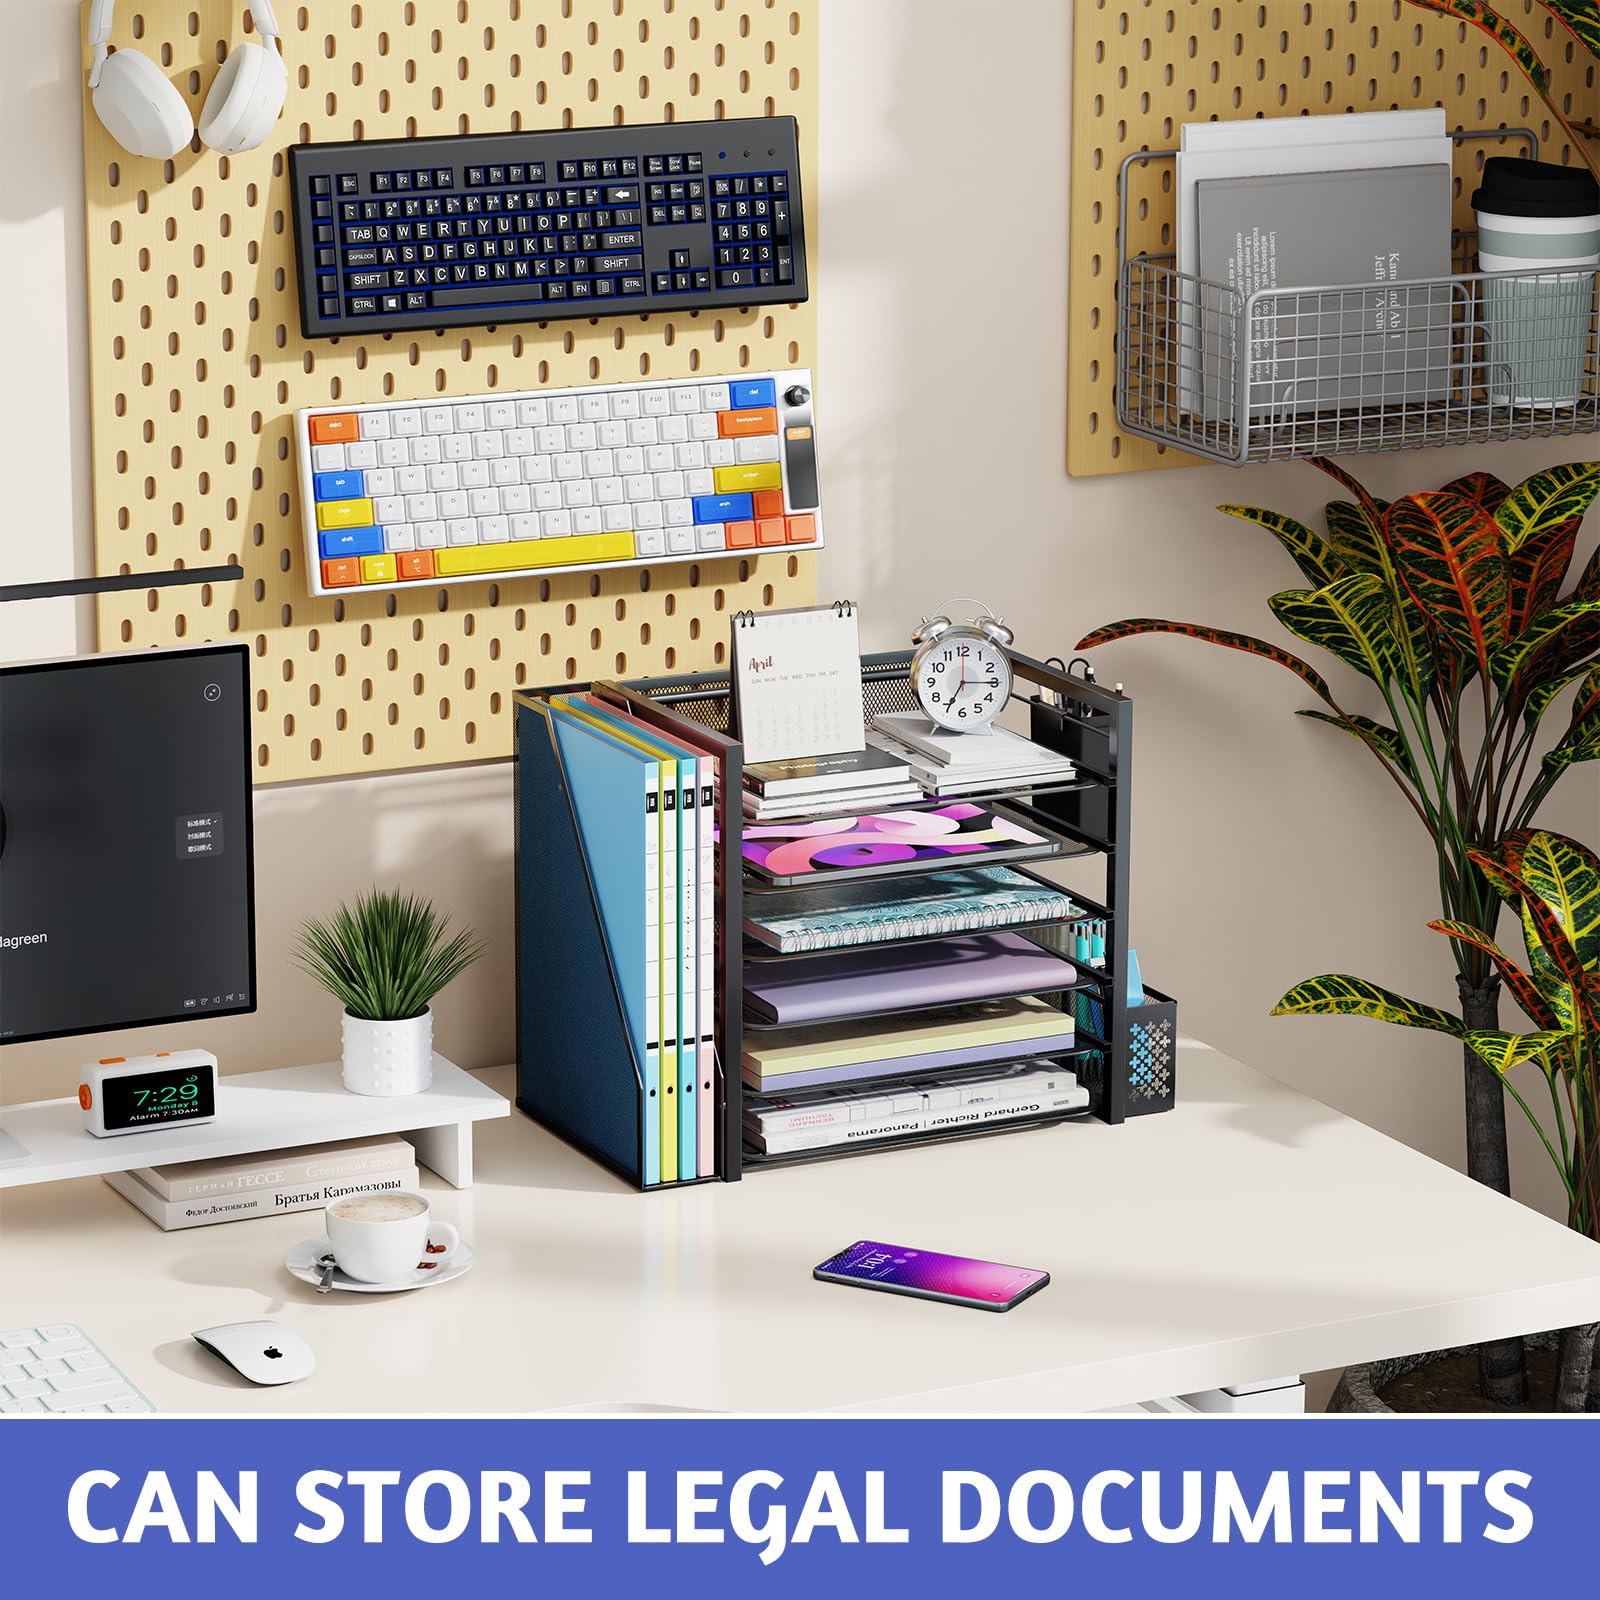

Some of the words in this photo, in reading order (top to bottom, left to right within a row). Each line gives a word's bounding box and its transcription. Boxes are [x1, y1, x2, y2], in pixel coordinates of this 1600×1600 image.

[584, 165, 596, 173] F10
[721, 205, 726, 215] 7
[739, 204, 746, 214] 8
[758, 203, 765, 213] 9
[351, 229, 370, 240] TAB
[379, 228, 388, 238] Q
[398, 227, 409, 236] W
[420, 225, 427, 235] E
[440, 224, 449, 234] R
[461, 223, 467, 232] T
[480, 221, 488, 231] Y
[500, 220, 509, 230] U
[522, 219, 526, 229] I
[539, 218, 549, 228] O
[560, 216, 568, 226] P
[722, 228, 729, 238] 4
[741, 226, 748, 237] 5
[760, 225, 767, 236] 6
[385, 250, 395, 261] A
[405, 249, 413, 260] S
[426, 247, 434, 257] D
[447, 246, 454, 256] F
[466, 245, 475, 255] G
[487, 243, 494, 254] H
[508, 242, 514, 252] J
[527, 240, 535, 250] K
[547, 239, 553, 248] L
[609, 235, 634, 244] ENTER
[724, 250, 729, 261] 1
[743, 249, 750, 259] 2
[762, 248, 769, 258] 3
[354, 275, 381, 285] SHIFT
[397, 272, 405, 282] Z
[416, 270, 425, 282] X
[438, 269, 446, 280] C
[457, 268, 466, 278] V
[479, 266, 487, 277] B
[497, 265, 505, 275] N
[517, 264, 527, 274] M
[604, 259, 629, 268] SHIFT
[732, 272, 739, 283] 0
[354, 300, 374, 309] CTRL
[409, 296, 424, 305] ALT
[552, 286, 562, 294] ALT
[577, 285, 587, 293] FN
[1390, 310, 1401, 341] Abl
[943, 651, 953, 661] 11
[956, 646, 970, 657] 12
[977, 650, 982, 661] 1
[748, 655, 774, 673] April
[931, 662, 945, 673] 10
[985, 662, 995, 673] 2
[926, 677, 936, 688] 9
[990, 677, 999, 688] 3
[931, 692, 941, 702] 8
[983, 692, 994, 702] 4
[942, 702, 952, 713] 7
[958, 707, 967, 718] 6
[973, 703, 983, 714] 5
[133, 1084, 198, 1106] 7:29
[147, 1102, 189, 1112] Monday
[984, 1104, 1040, 1119] Gerhard
[129, 1112, 160, 1121] Alarm
[162, 1107, 199, 1117] 7:30AM
[930, 1113, 980, 1126] Richter
[847, 1122, 919, 1138] Panorama
[237, 1170, 285, 1188] ГЕССЕ
[274, 1189, 321, 1208] Братья
[323, 1180, 402, 1200] Карамазовы
